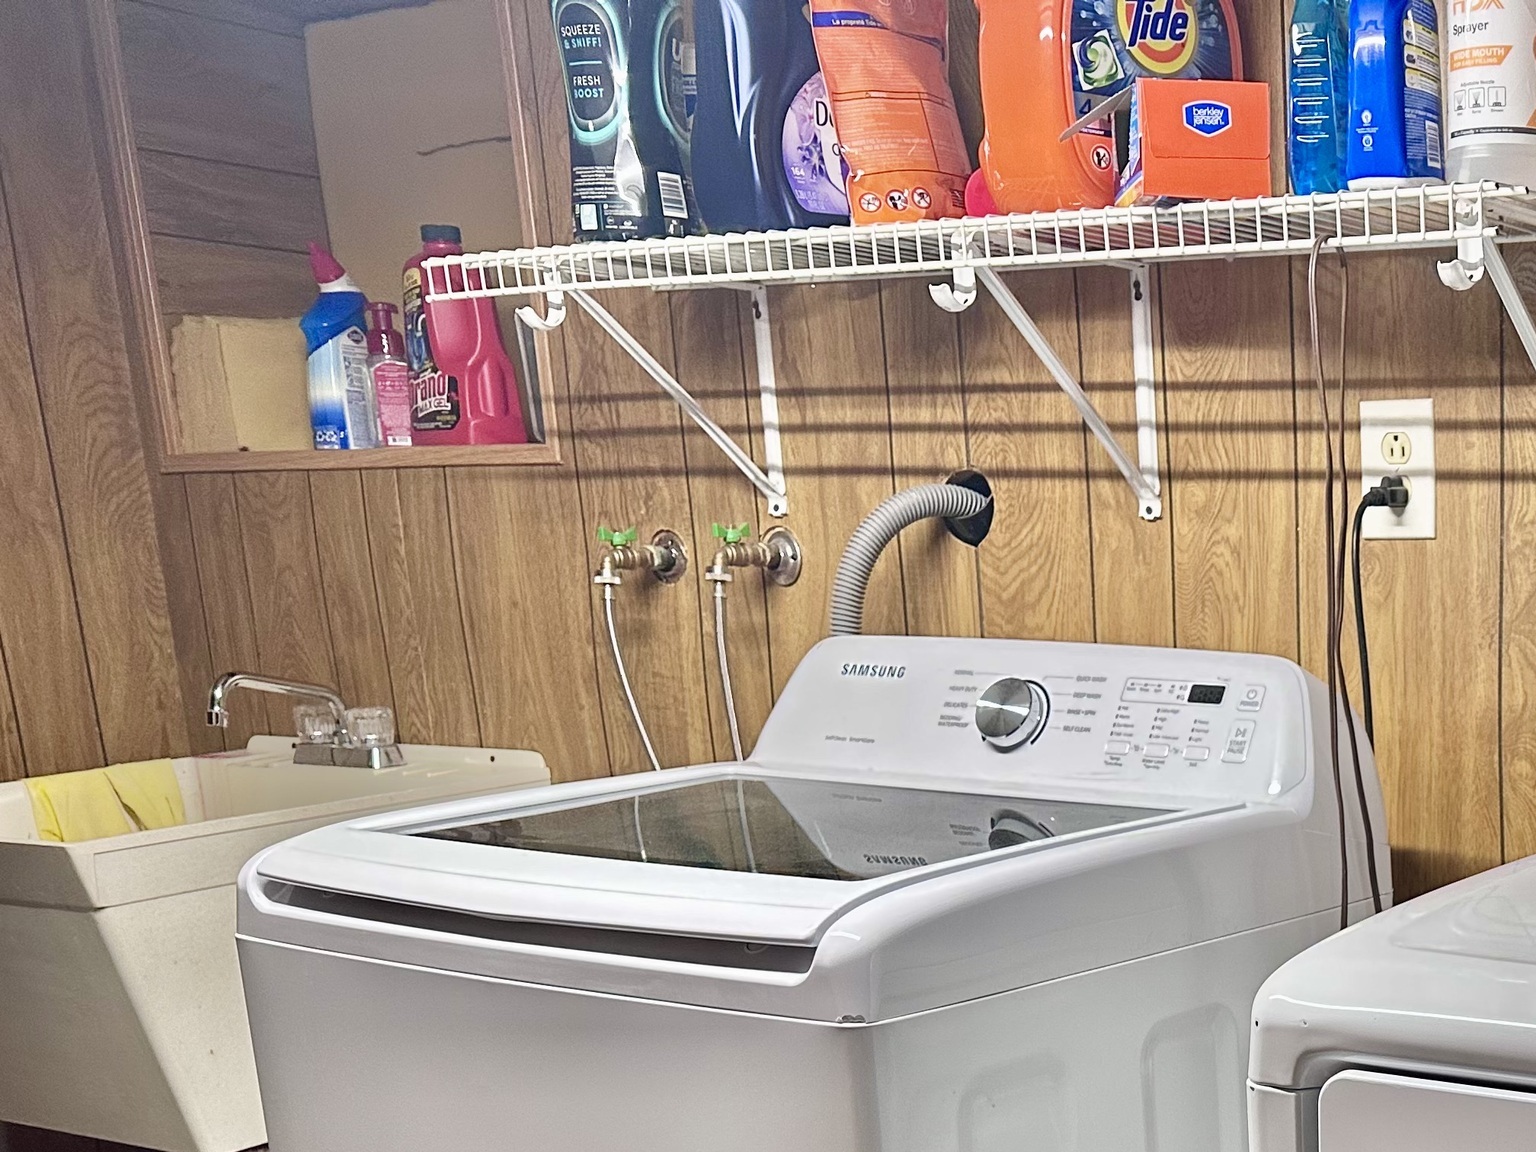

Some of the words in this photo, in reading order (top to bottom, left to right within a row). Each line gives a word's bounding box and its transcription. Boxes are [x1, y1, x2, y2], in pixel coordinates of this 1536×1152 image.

[1127, 0, 1189, 47] Tide
[1453, 22, 1489, 36] Sprayer
[560, 24, 601, 36] SQUEEZE
[564, 39, 570, 49] &
[572, 37, 602, 48] SNIFF!
[1472, 48, 1504, 58] MOUTH
[573, 76, 600, 86] FRESH
[574, 88, 604, 98] BOOST
[841, 664, 906, 678] SAMSUNG
